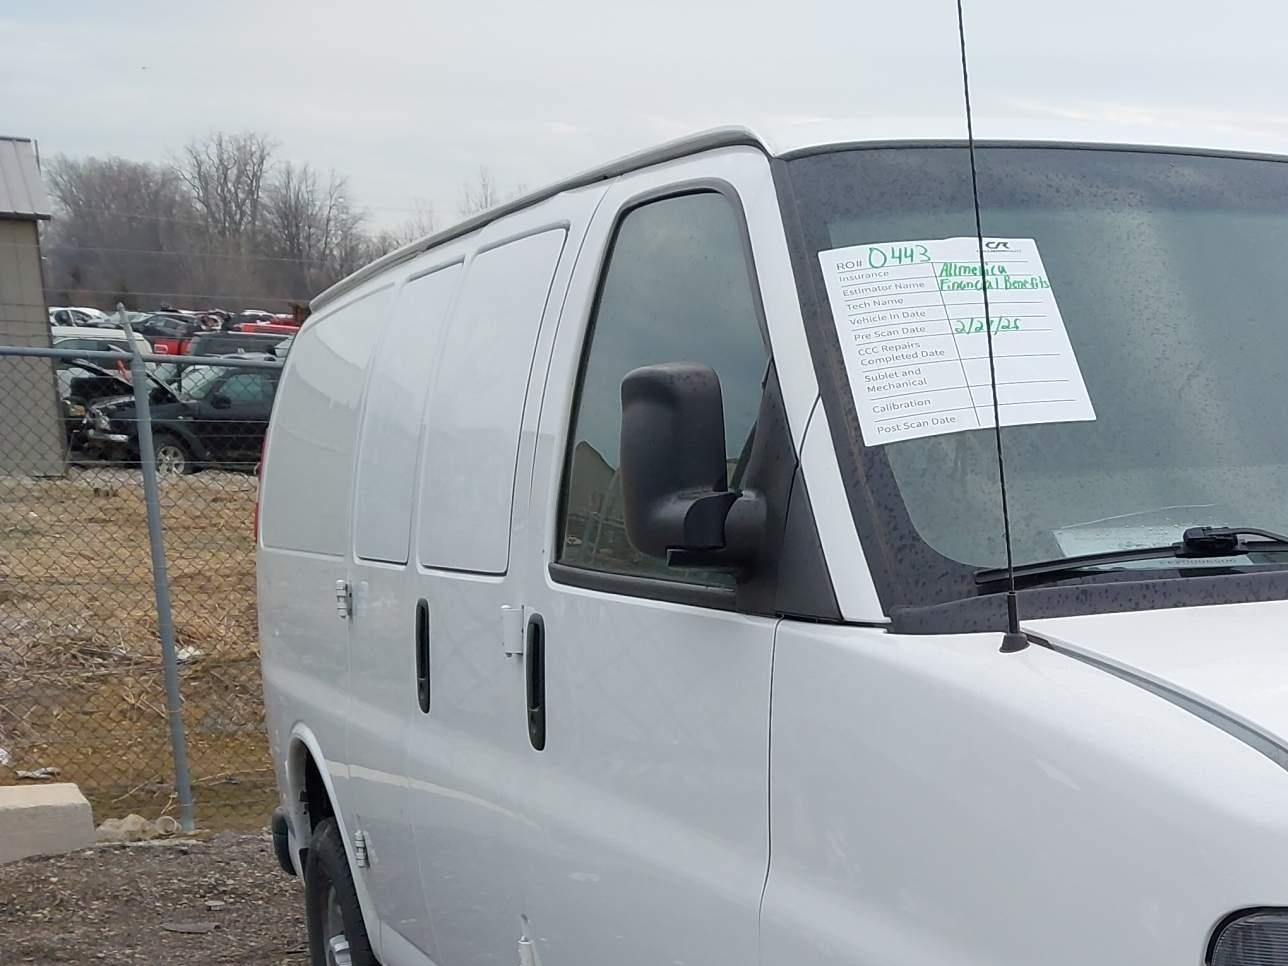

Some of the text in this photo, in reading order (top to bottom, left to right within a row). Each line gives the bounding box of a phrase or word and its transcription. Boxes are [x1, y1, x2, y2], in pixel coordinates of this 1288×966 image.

[868, 244, 931, 269] 0443
[839, 271, 889, 283] Insurance
[940, 278, 999, 291] Financal
[842, 281, 925, 297] Estimator Name
[847, 298, 904, 311] Tech Name
[849, 315, 887, 325] Vehicle
[902, 310, 926, 319] Date
[853, 325, 926, 342] Pre Scan Date
[858, 341, 921, 357] CCC Repairs
[860, 349, 945, 367] Completed Date
[864, 368, 921, 383] Sublet and
[866, 378, 928, 393] Mechanical
[872, 398, 931, 414] Calibration
[877, 416, 957, 435] Post Scan Date
